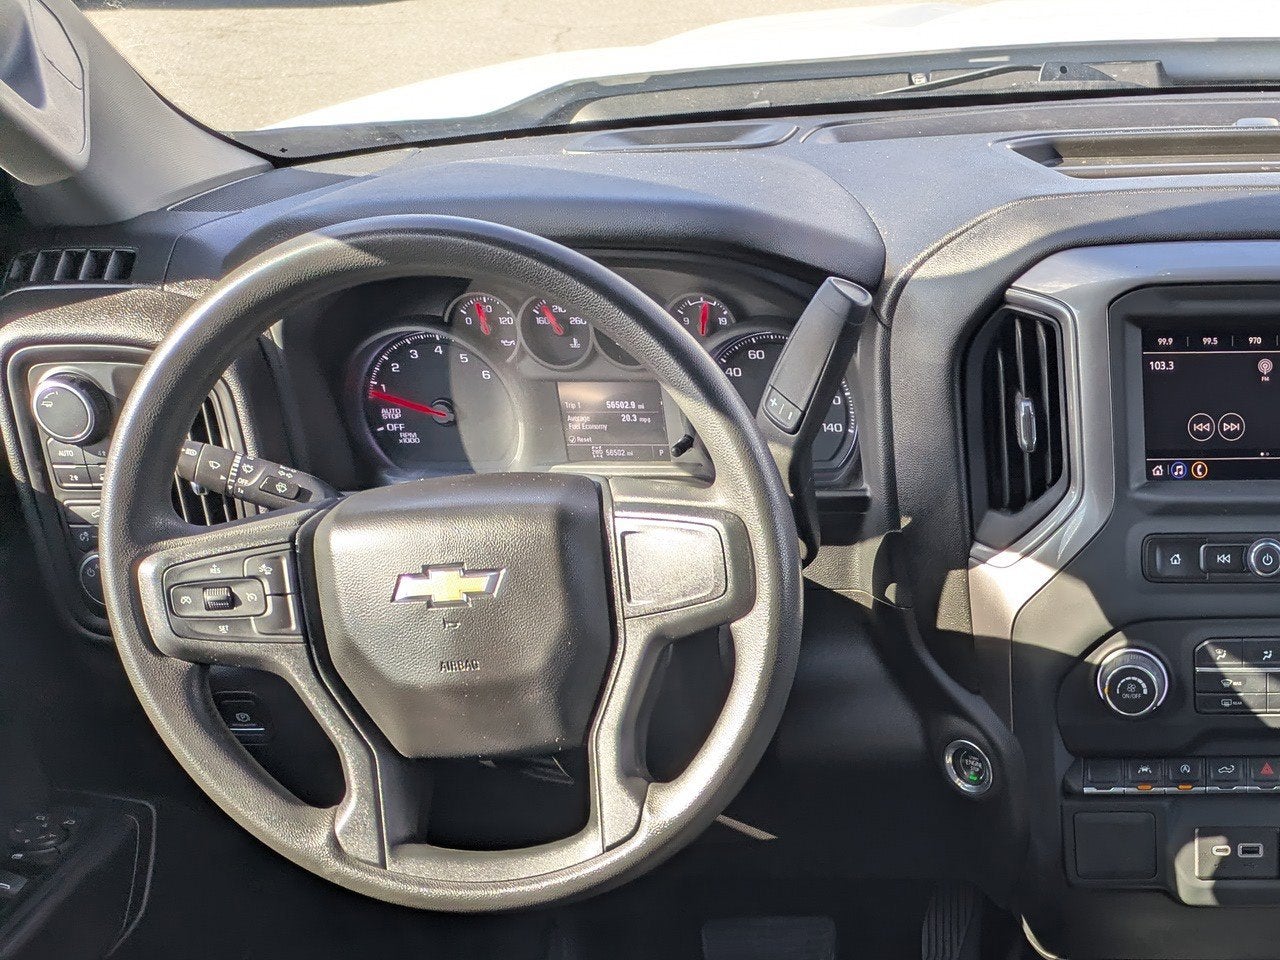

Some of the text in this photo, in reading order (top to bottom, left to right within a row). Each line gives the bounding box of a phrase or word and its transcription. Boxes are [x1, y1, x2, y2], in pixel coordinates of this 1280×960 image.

[464, 317, 472, 325] 0
[498, 317, 514, 325] 120
[683, 317, 690, 326] 9
[718, 317, 728, 326] 19
[1157, 337, 1174, 346] 99.9
[1202, 337, 1219, 346] 99.5
[1248, 336, 1262, 345] 970
[409, 349, 419, 359] 3
[434, 345, 443, 355] 4
[747, 349, 765, 360] 60
[459, 353, 469, 363] 5
[391, 363, 400, 373] 2
[1149, 361, 1175, 371] 103.3
[482, 370, 491, 380] 6
[725, 367, 742, 377] 40
[564, 401, 577, 410] Trip
[605, 400, 636, 410] 56502.9
[621, 413, 638, 423] 20.3
[386, 423, 405, 431] OFF
[582, 423, 608, 431] Economy
[822, 423, 843, 433] 140
[439, 660, 480, 673] AIRBAG
